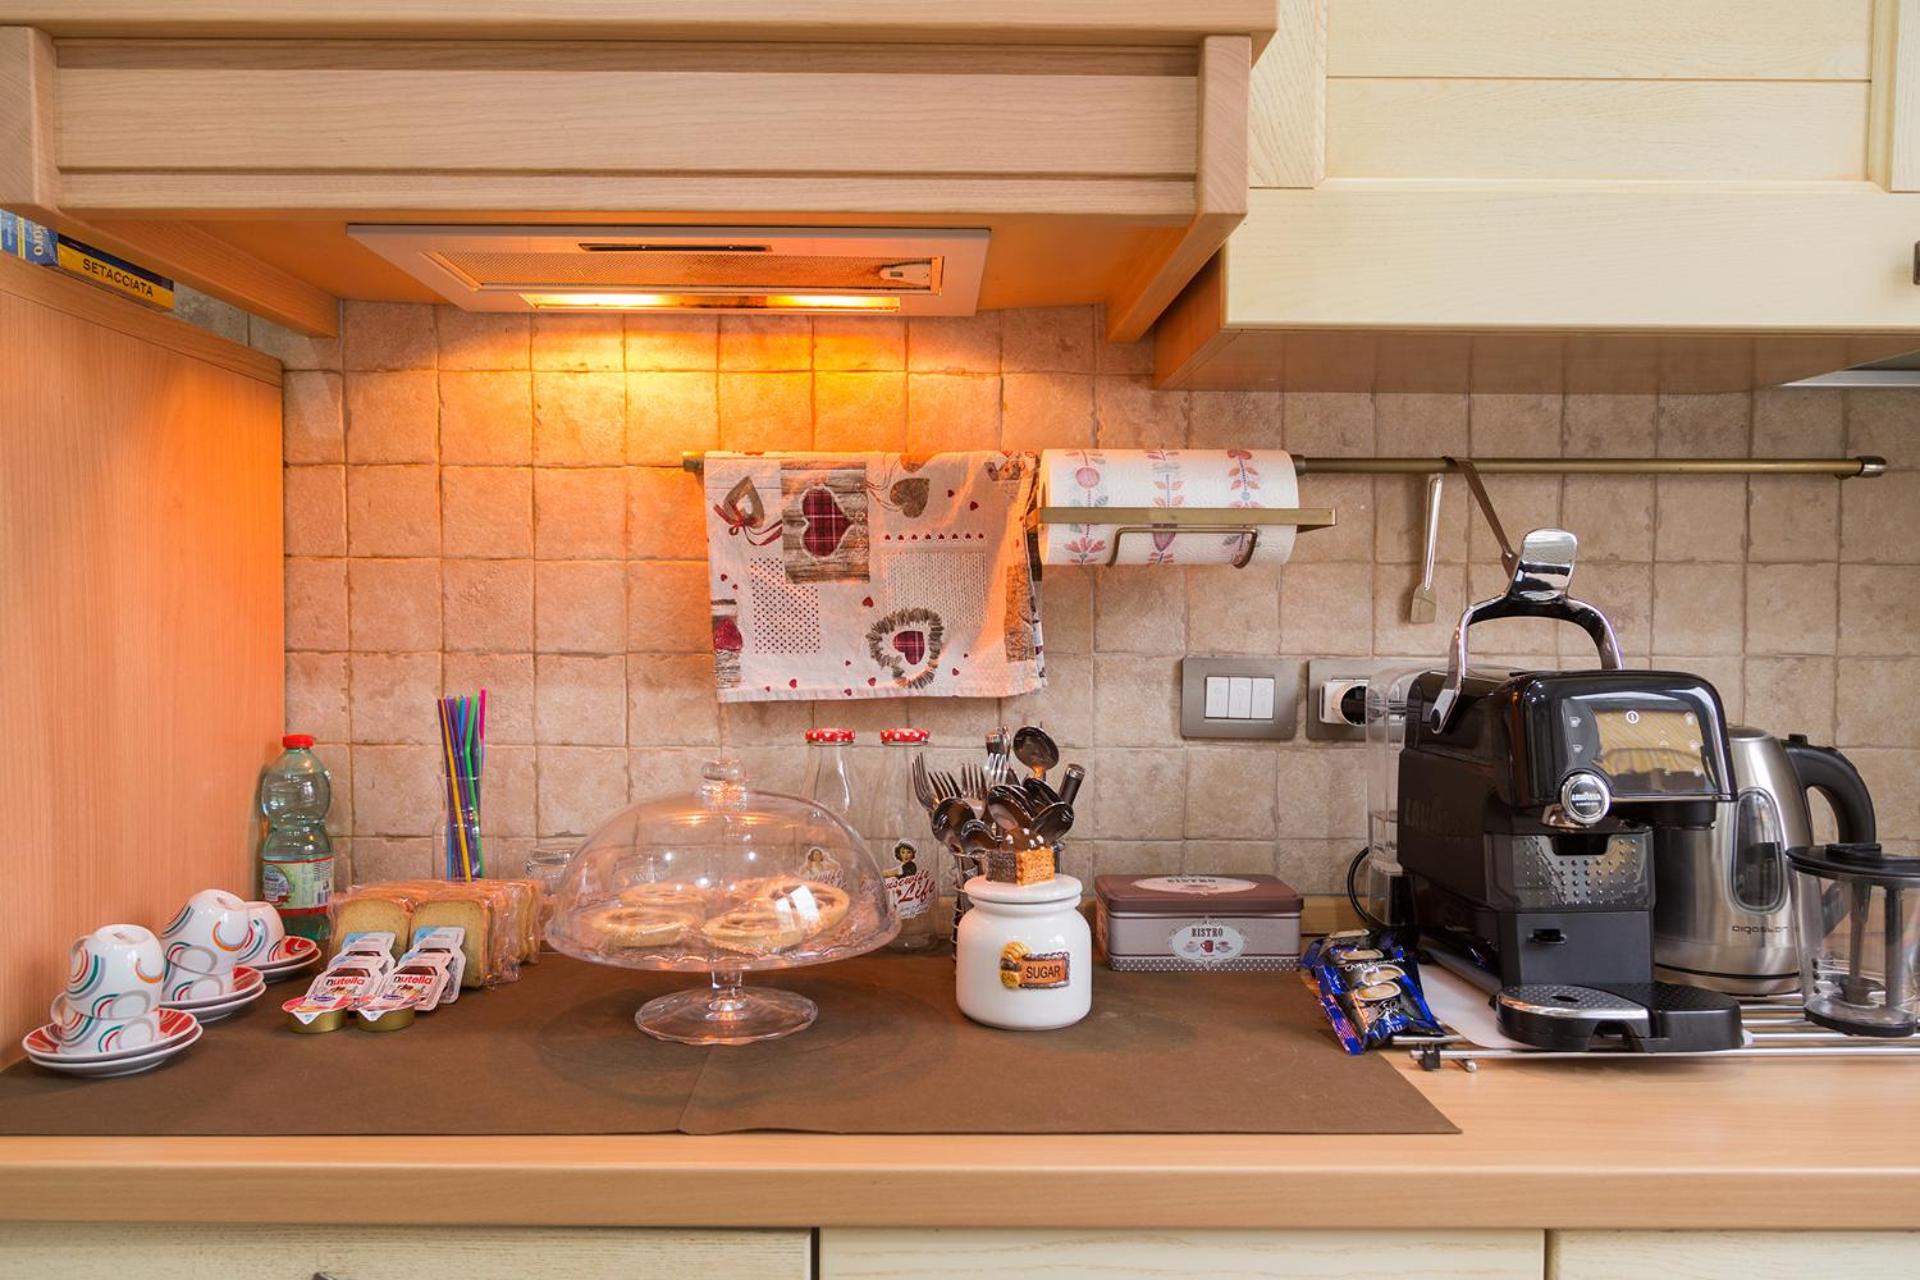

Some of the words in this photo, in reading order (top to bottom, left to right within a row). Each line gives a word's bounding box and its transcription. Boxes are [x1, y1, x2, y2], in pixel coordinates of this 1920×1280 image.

[82, 258, 154, 297] SETACCIATA
[1191, 927, 1223, 938] BISTRO
[1025, 964, 1061, 979] SUGAR
[325, 975, 365, 986] nutella
[393, 974, 433, 986] nutella
